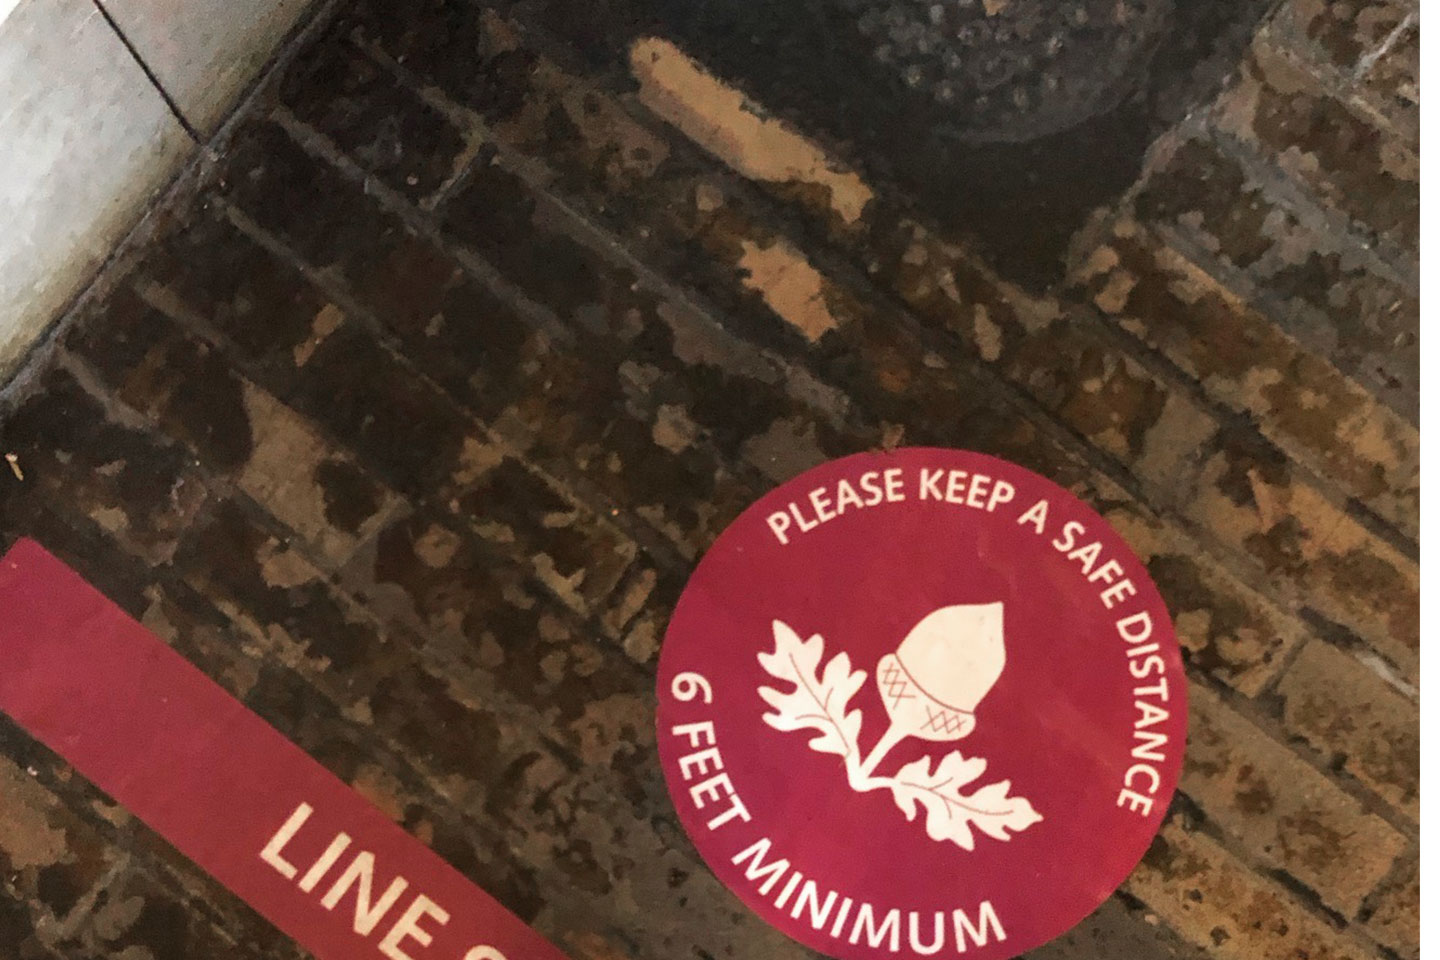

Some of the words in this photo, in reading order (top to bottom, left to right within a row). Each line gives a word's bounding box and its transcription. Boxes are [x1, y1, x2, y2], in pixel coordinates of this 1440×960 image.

[671, 671, 712, 704] 6
[766, 469, 905, 544] PLEASE
[919, 468, 1015, 512] KEEP
[1018, 501, 1049, 534] A
[1053, 521, 1137, 608] SAFE
[1116, 611, 1170, 816] DISTANCE
[671, 719, 751, 830] FEET
[731, 837, 1007, 955] MINIMUM
